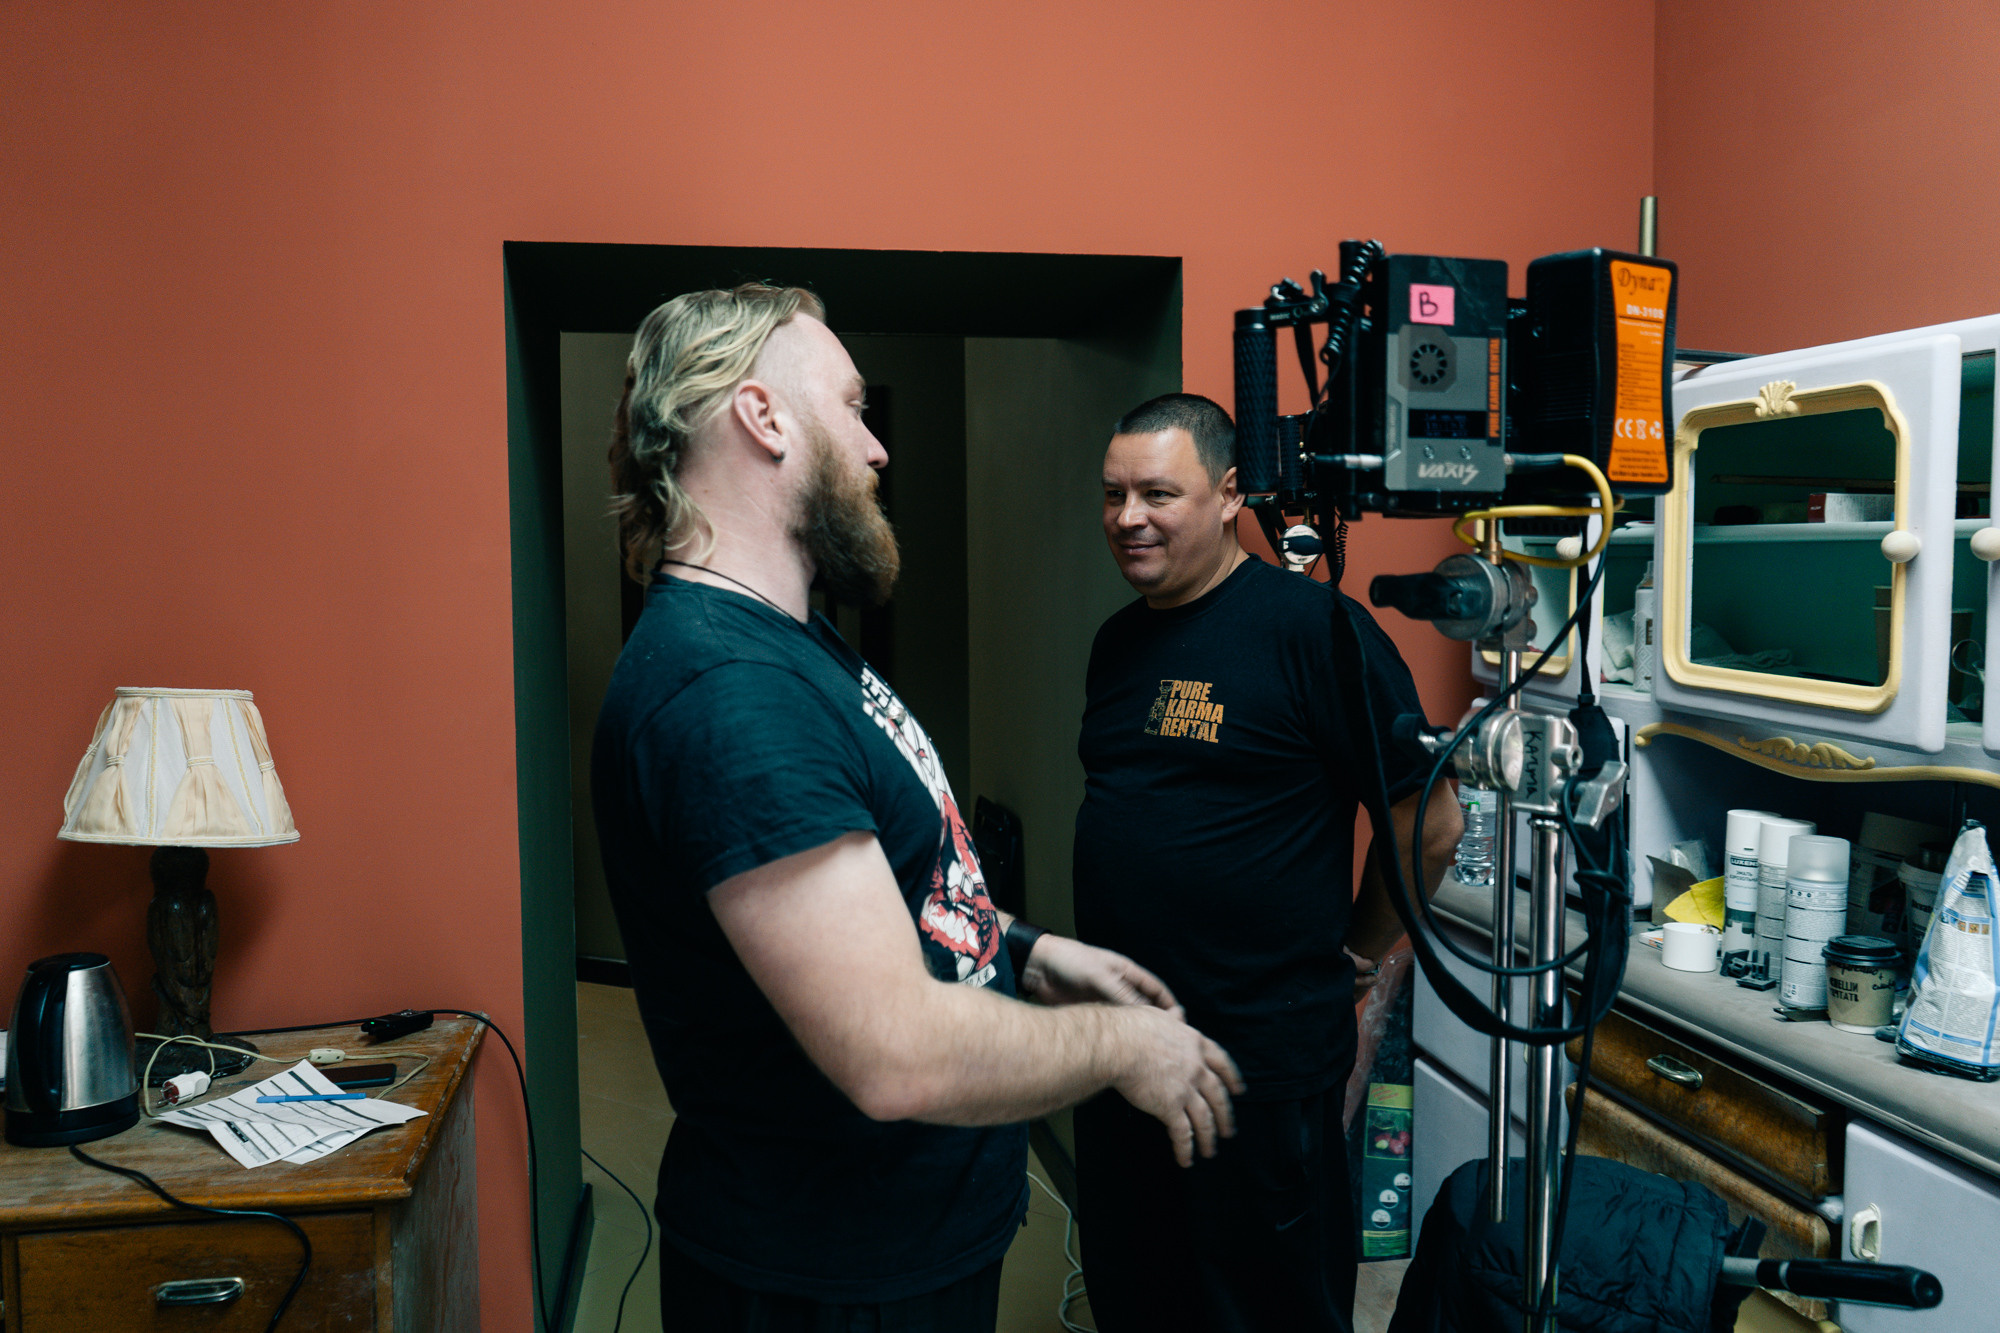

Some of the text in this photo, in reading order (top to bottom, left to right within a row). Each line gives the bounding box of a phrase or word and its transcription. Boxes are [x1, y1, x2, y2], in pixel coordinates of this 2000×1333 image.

[1419, 292, 1438, 317] B
[1488, 337, 1500, 438] PURE KARMA RENTAL
[1417, 462, 1480, 486] VAXIS
[1170, 679, 1213, 701] PURE
[1165, 698, 1224, 724] KARMA
[1160, 717, 1219, 743] RENTAL
